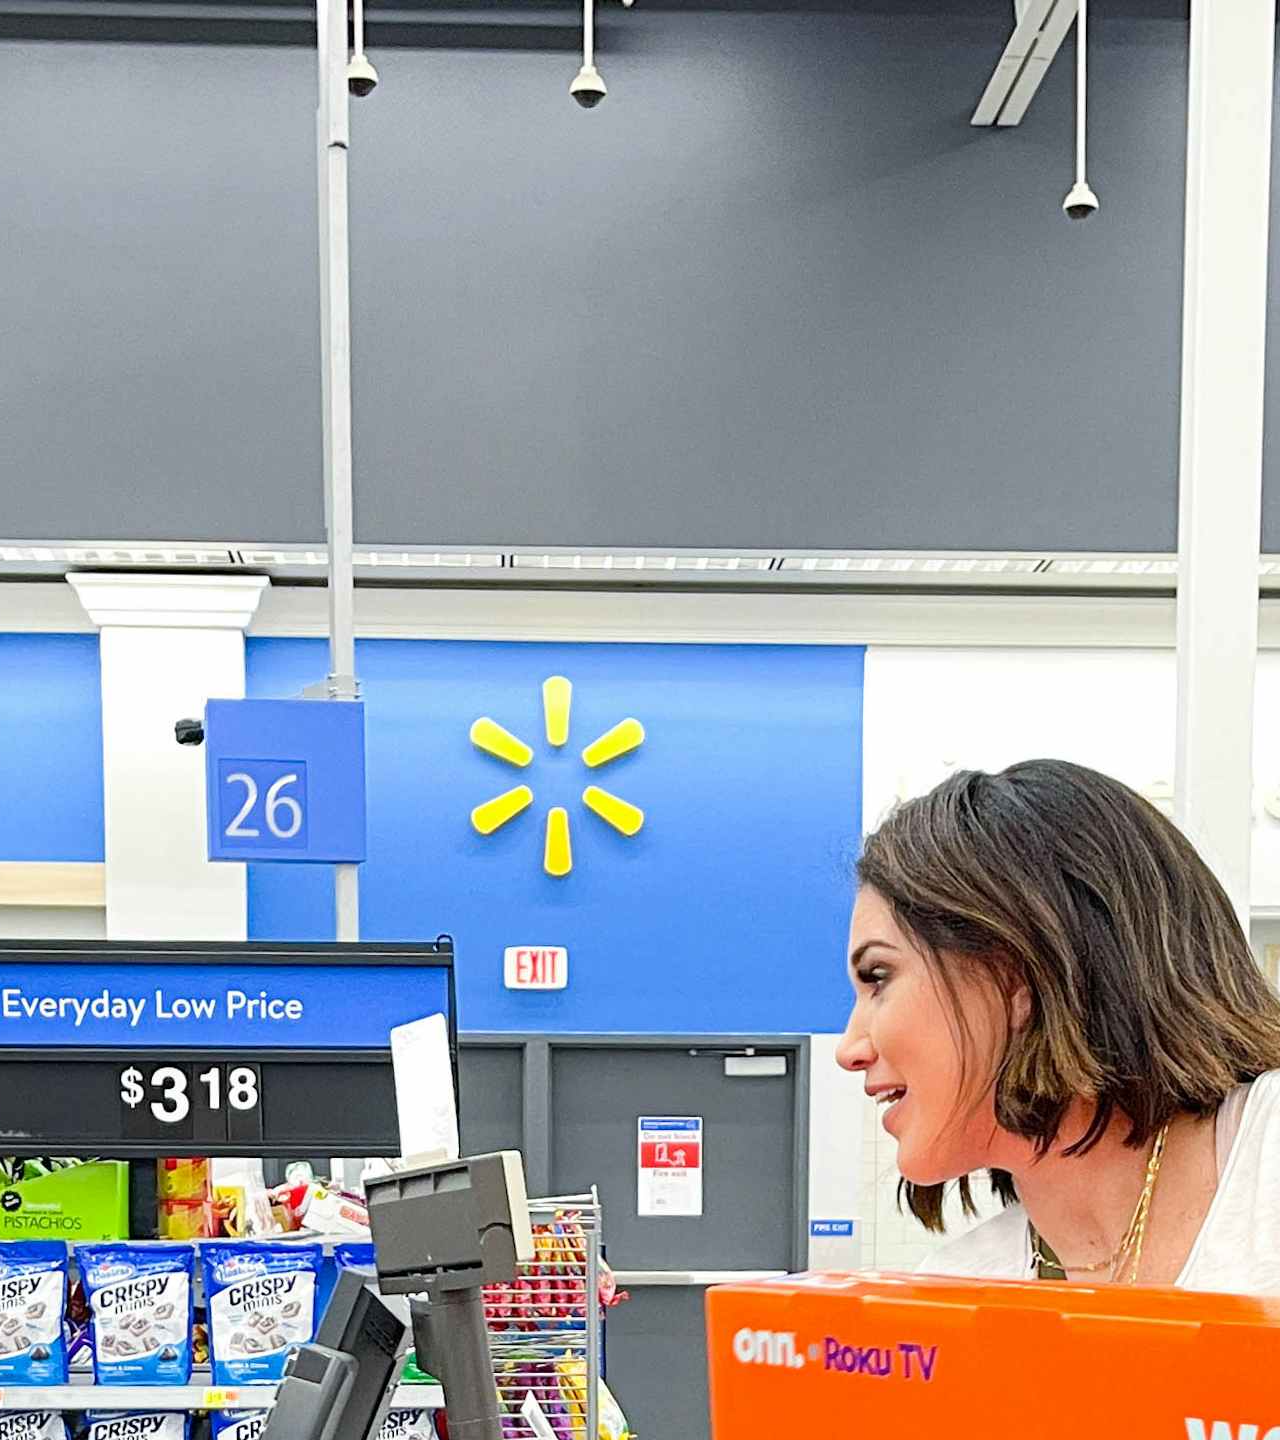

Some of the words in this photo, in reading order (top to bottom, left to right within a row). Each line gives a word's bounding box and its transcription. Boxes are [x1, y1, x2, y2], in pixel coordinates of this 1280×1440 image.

[224, 771, 304, 840] 26
[516, 950, 560, 985] EXIT
[1, 988, 146, 1026] Everyday
[155, 989, 216, 1019] Low
[226, 989, 304, 1020] Price
[3, 1215, 82, 1232] PISTACHIOS
[734, 1325, 806, 1371] onn.
[899, 1342, 940, 1382] TV
